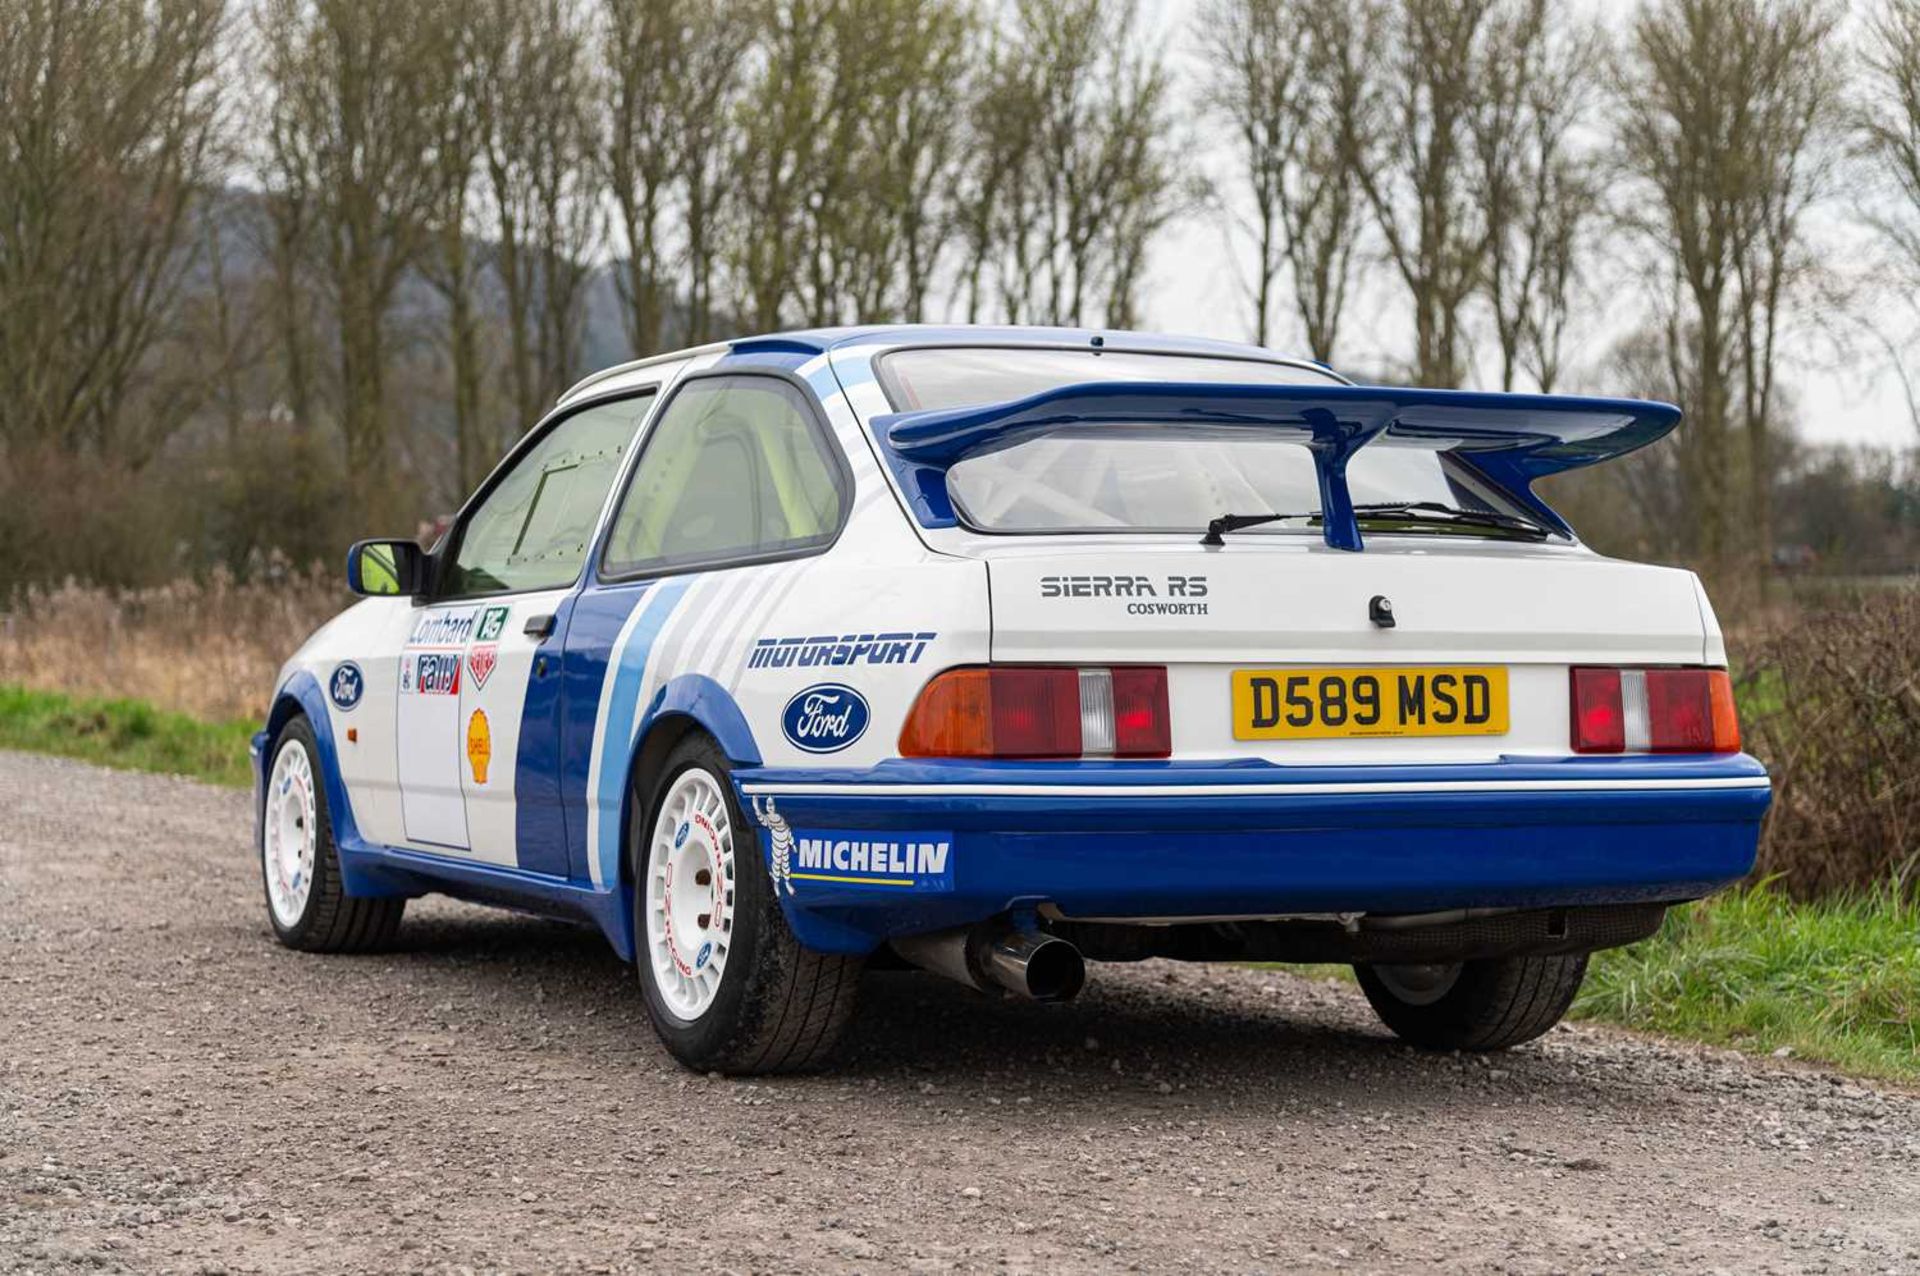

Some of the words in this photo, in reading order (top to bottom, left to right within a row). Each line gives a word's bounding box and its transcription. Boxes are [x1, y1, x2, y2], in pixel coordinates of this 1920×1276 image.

[1041, 576, 1157, 597] SIERRA
[1168, 576, 1208, 597] RS
[409, 608, 479, 644] Lombard
[1127, 602, 1208, 616] COSWORTH
[748, 632, 938, 669] MOTORSPORT
[333, 666, 358, 701] Ford
[1250, 676, 1381, 729] D589
[1398, 674, 1491, 725] MSD
[796, 693, 853, 738] Ford
[798, 838, 950, 875] MICHELIN
